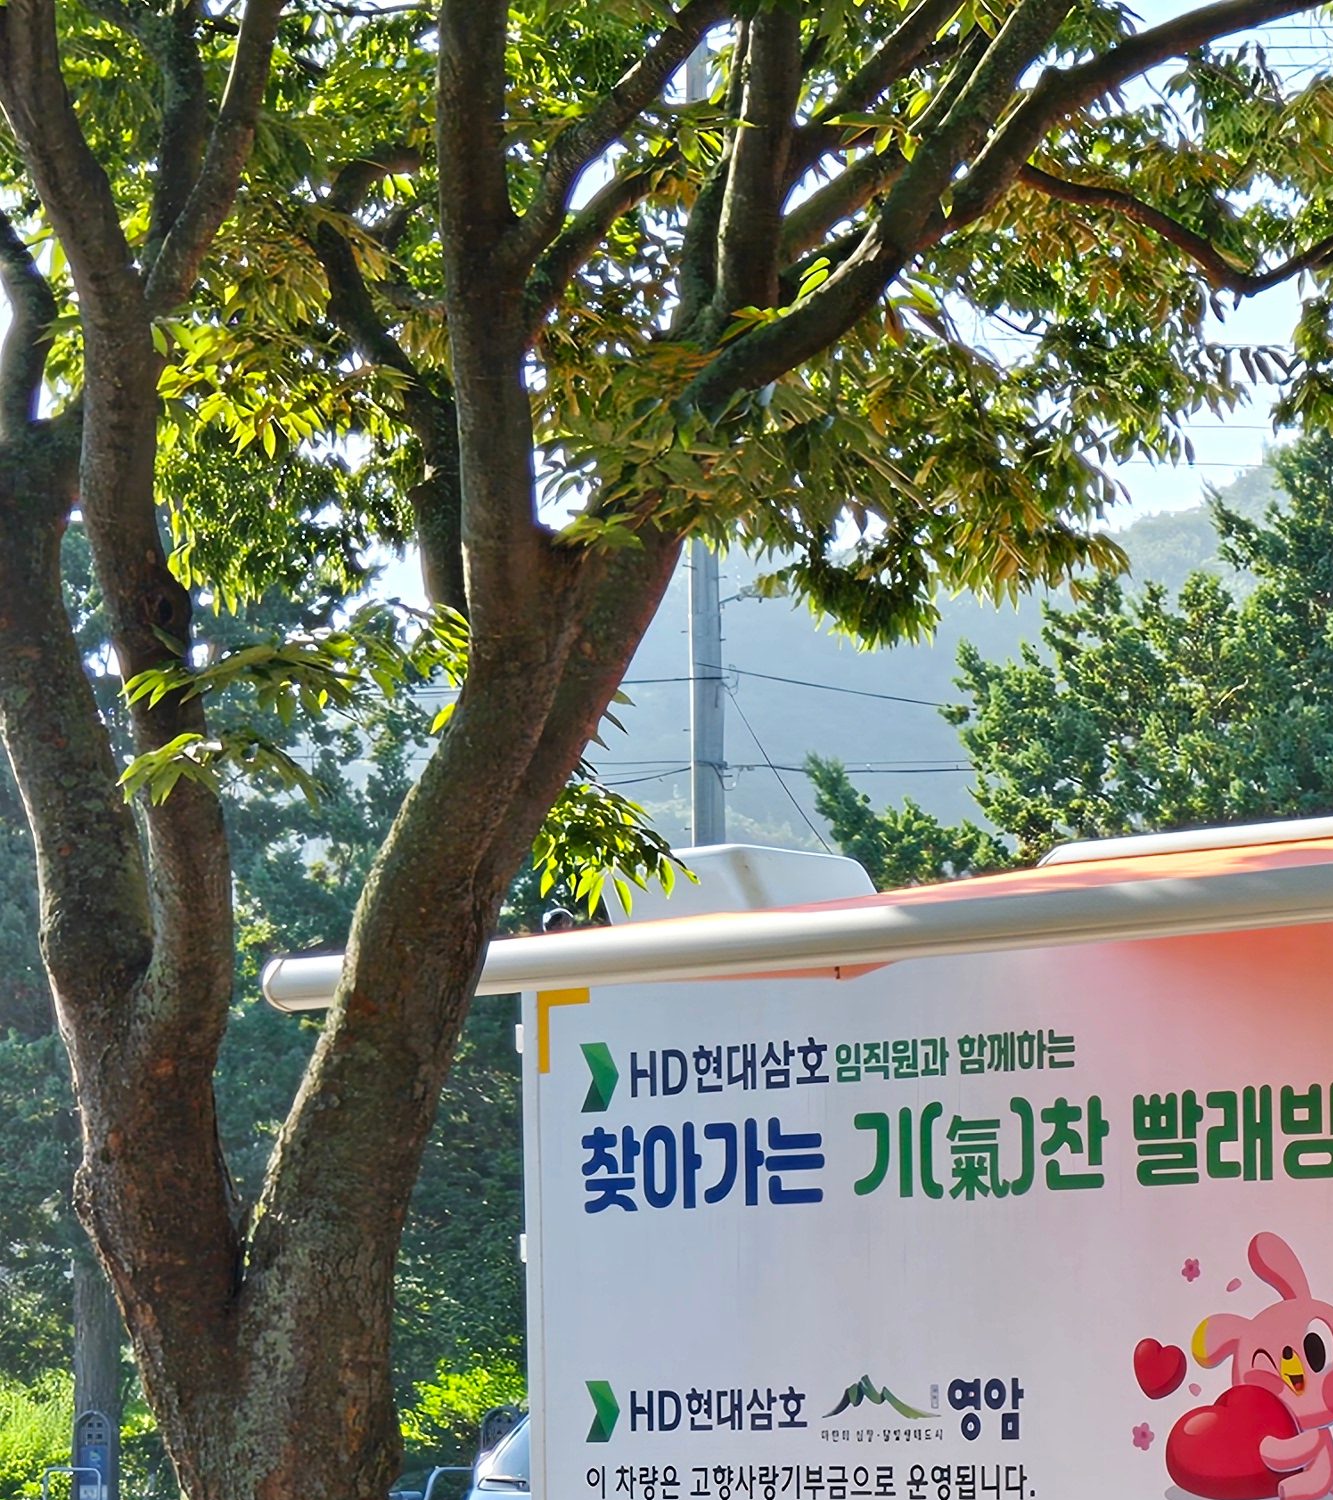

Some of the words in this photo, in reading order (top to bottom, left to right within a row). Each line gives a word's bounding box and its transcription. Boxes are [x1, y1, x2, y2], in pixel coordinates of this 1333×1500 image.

[630, 1037, 829, 1098] HD현대삼호
[835, 1036, 949, 1082] 임직원과
[957, 1029, 1076, 1075] 함께하는
[581, 1117, 825, 1214] 찾아가는
[853, 1095, 1110, 1200] 기(氣)찬
[630, 1386, 808, 1432] HD현대삼호
[947, 1377, 1025, 1442] 영암
[586, 1466, 606, 1499] 이
[615, 1465, 681, 1500] 차량은
[689, 1464, 897, 1500] 고향사랑기부금으로
[905, 1463, 1036, 1500] 운영됩니다.
